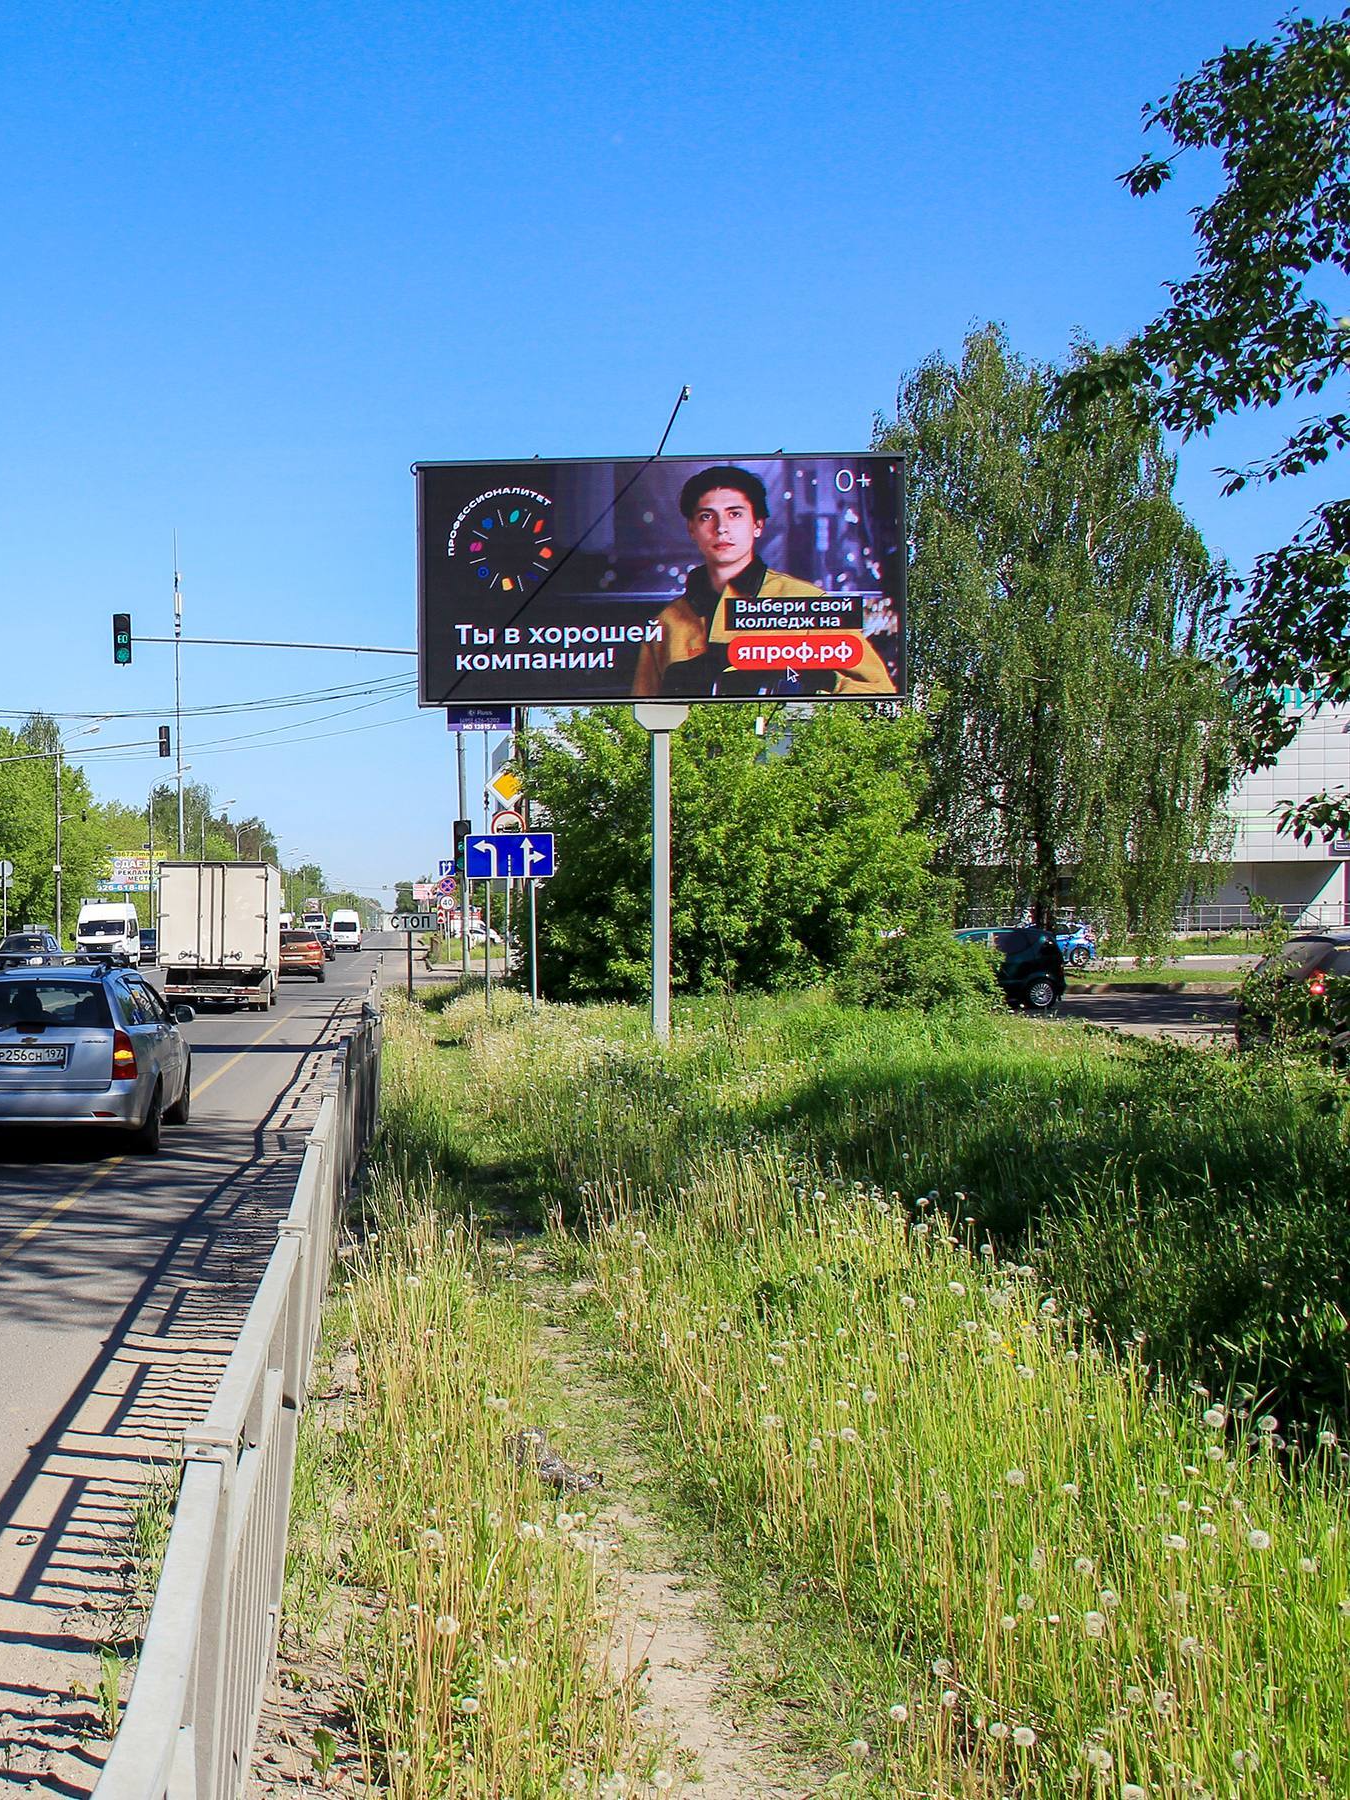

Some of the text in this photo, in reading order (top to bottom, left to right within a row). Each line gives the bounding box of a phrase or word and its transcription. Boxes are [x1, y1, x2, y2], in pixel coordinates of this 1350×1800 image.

[835, 469, 871, 492] 0+
[448, 487, 552, 556] ПРОФЕССИОНАЛИТЕТ
[735, 598, 852, 615] Выбери свой
[454, 619, 663, 648] Ты в хорошей
[735, 616, 840, 629] колледж на
[455, 648, 615, 670] компании!
[737, 641, 853, 663] япроф.рф
[391, 915, 430, 929] СТОП
[45, 1049, 61, 1058] 197
